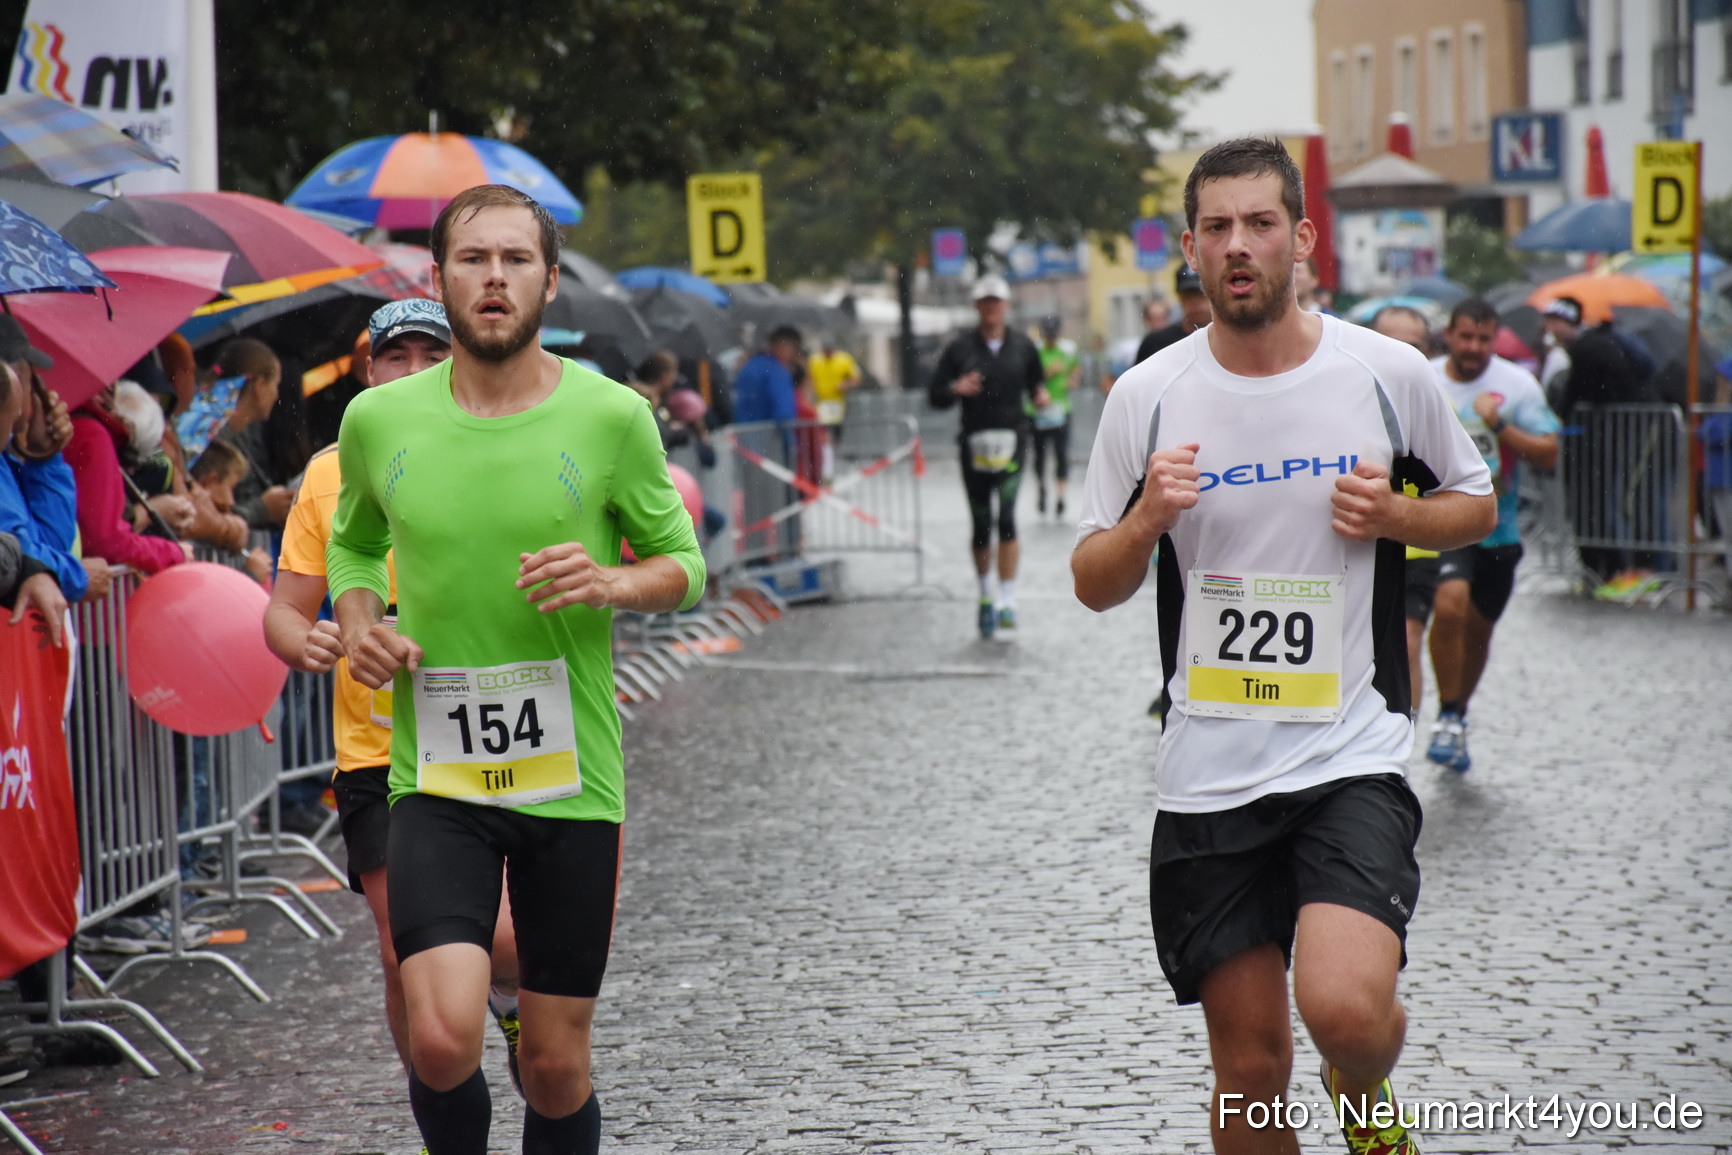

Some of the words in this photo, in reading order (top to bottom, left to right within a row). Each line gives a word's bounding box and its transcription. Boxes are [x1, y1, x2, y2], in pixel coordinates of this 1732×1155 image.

[1653, 177, 1684, 226] D
[711, 210, 743, 258] D
[1200, 586, 1245, 598] NeuerMarkt
[1254, 578, 1331, 598] BOCK
[1218, 608, 1314, 665] 229
[423, 684, 470, 693] NeuerMarkt
[477, 666, 554, 690] BOCK
[1243, 678, 1280, 700] Tim
[447, 697, 544, 755] 154
[481, 768, 514, 790] Till
